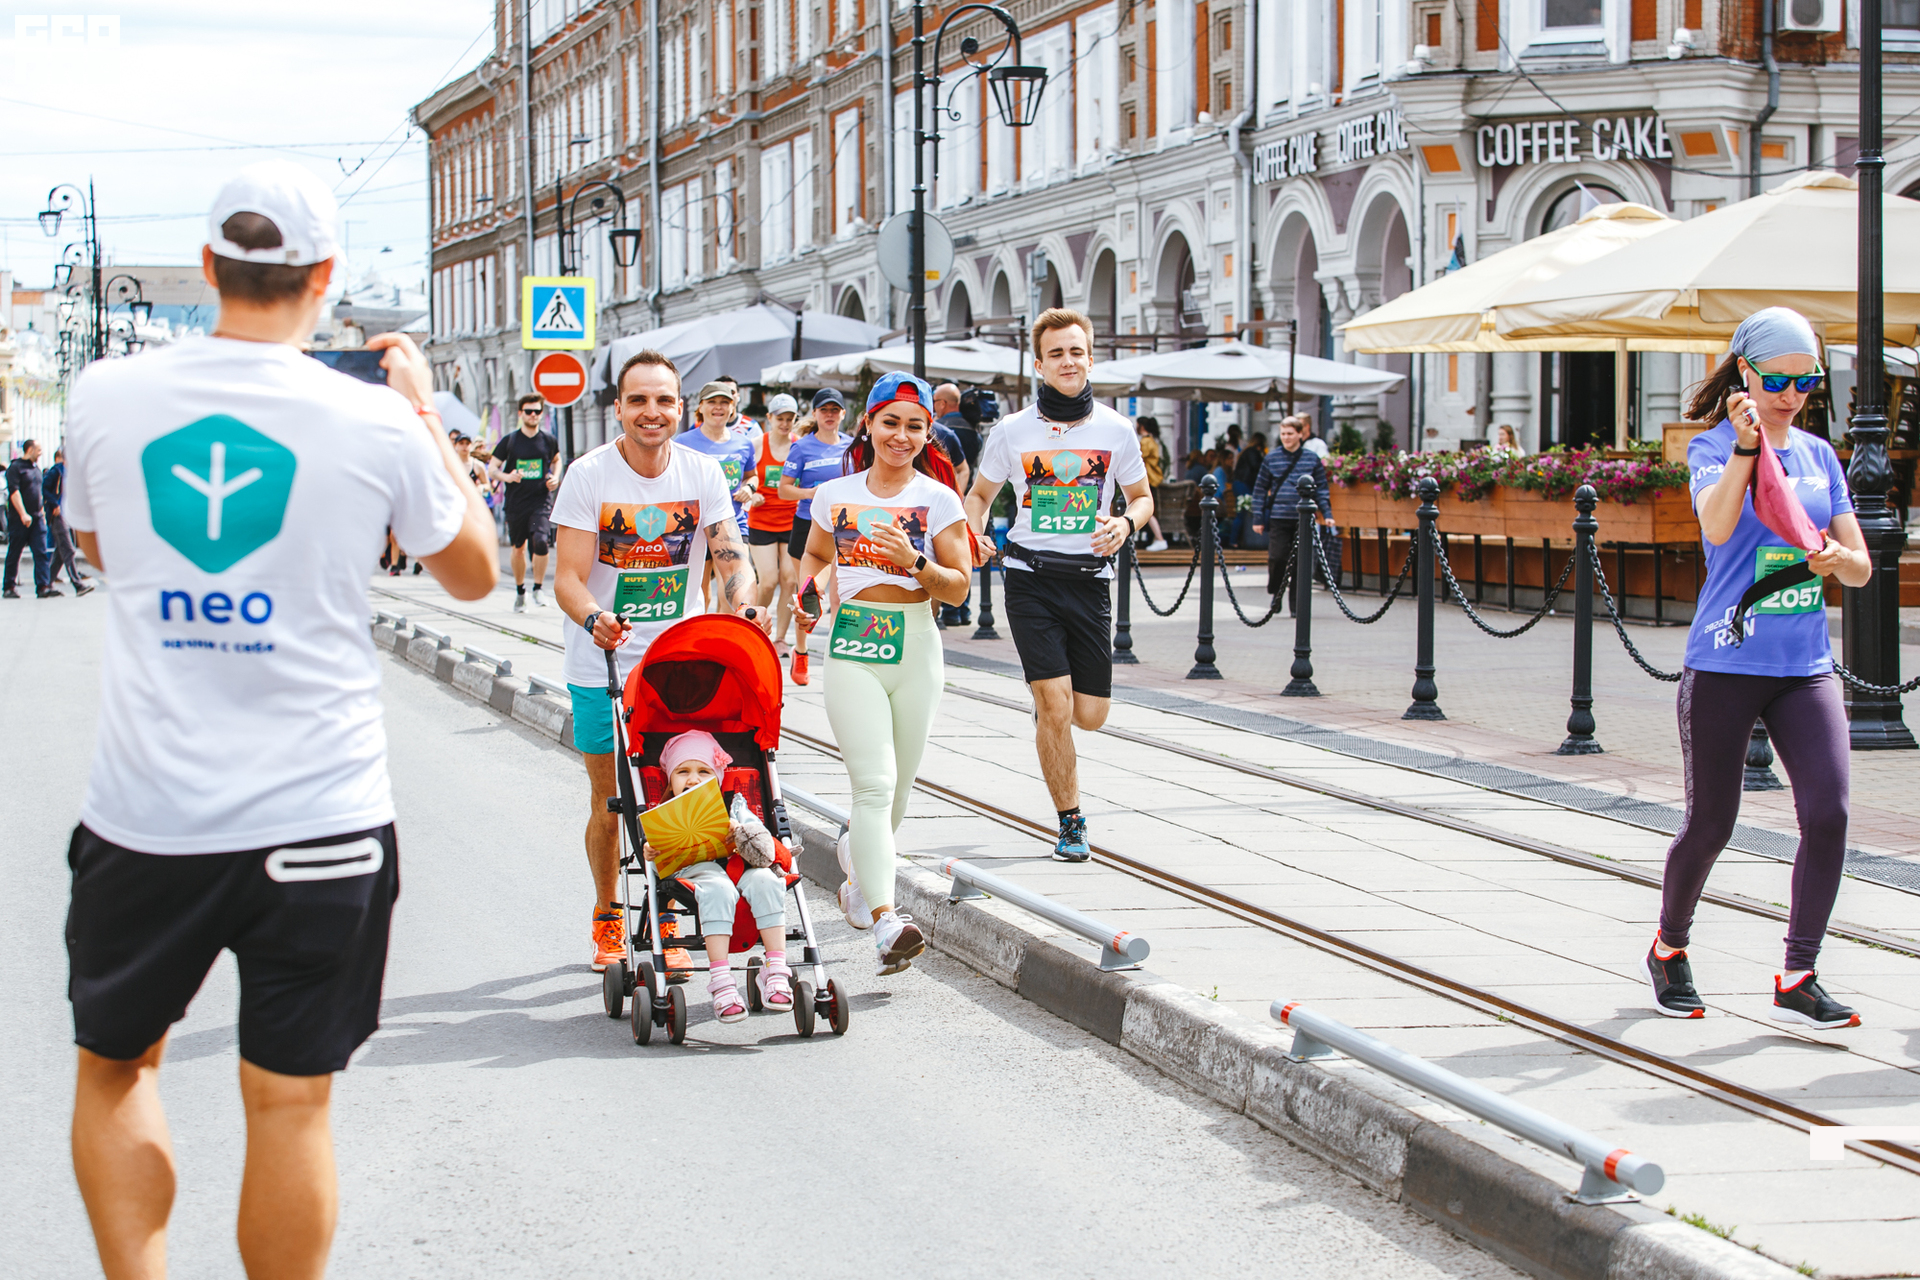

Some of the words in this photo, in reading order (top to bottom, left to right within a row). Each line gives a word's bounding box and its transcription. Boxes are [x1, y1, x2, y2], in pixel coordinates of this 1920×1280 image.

[1336, 114, 1375, 164] COFFEE
[1477, 119, 1581, 167] COFFEE
[1592, 115, 1673, 161] CAKE
[1253, 138, 1288, 185] COFFEE
[1288, 131, 1317, 177] CAKE
[1038, 515, 1090, 530] 2137
[636, 544, 663, 553] neo
[1765, 552, 1794, 561] RUTS
[161, 590, 273, 624] neo
[1761, 585, 1821, 608] 2057
[622, 600, 677, 618] 2219
[841, 608, 860, 617] RUTS
[833, 637, 896, 660] 2220
